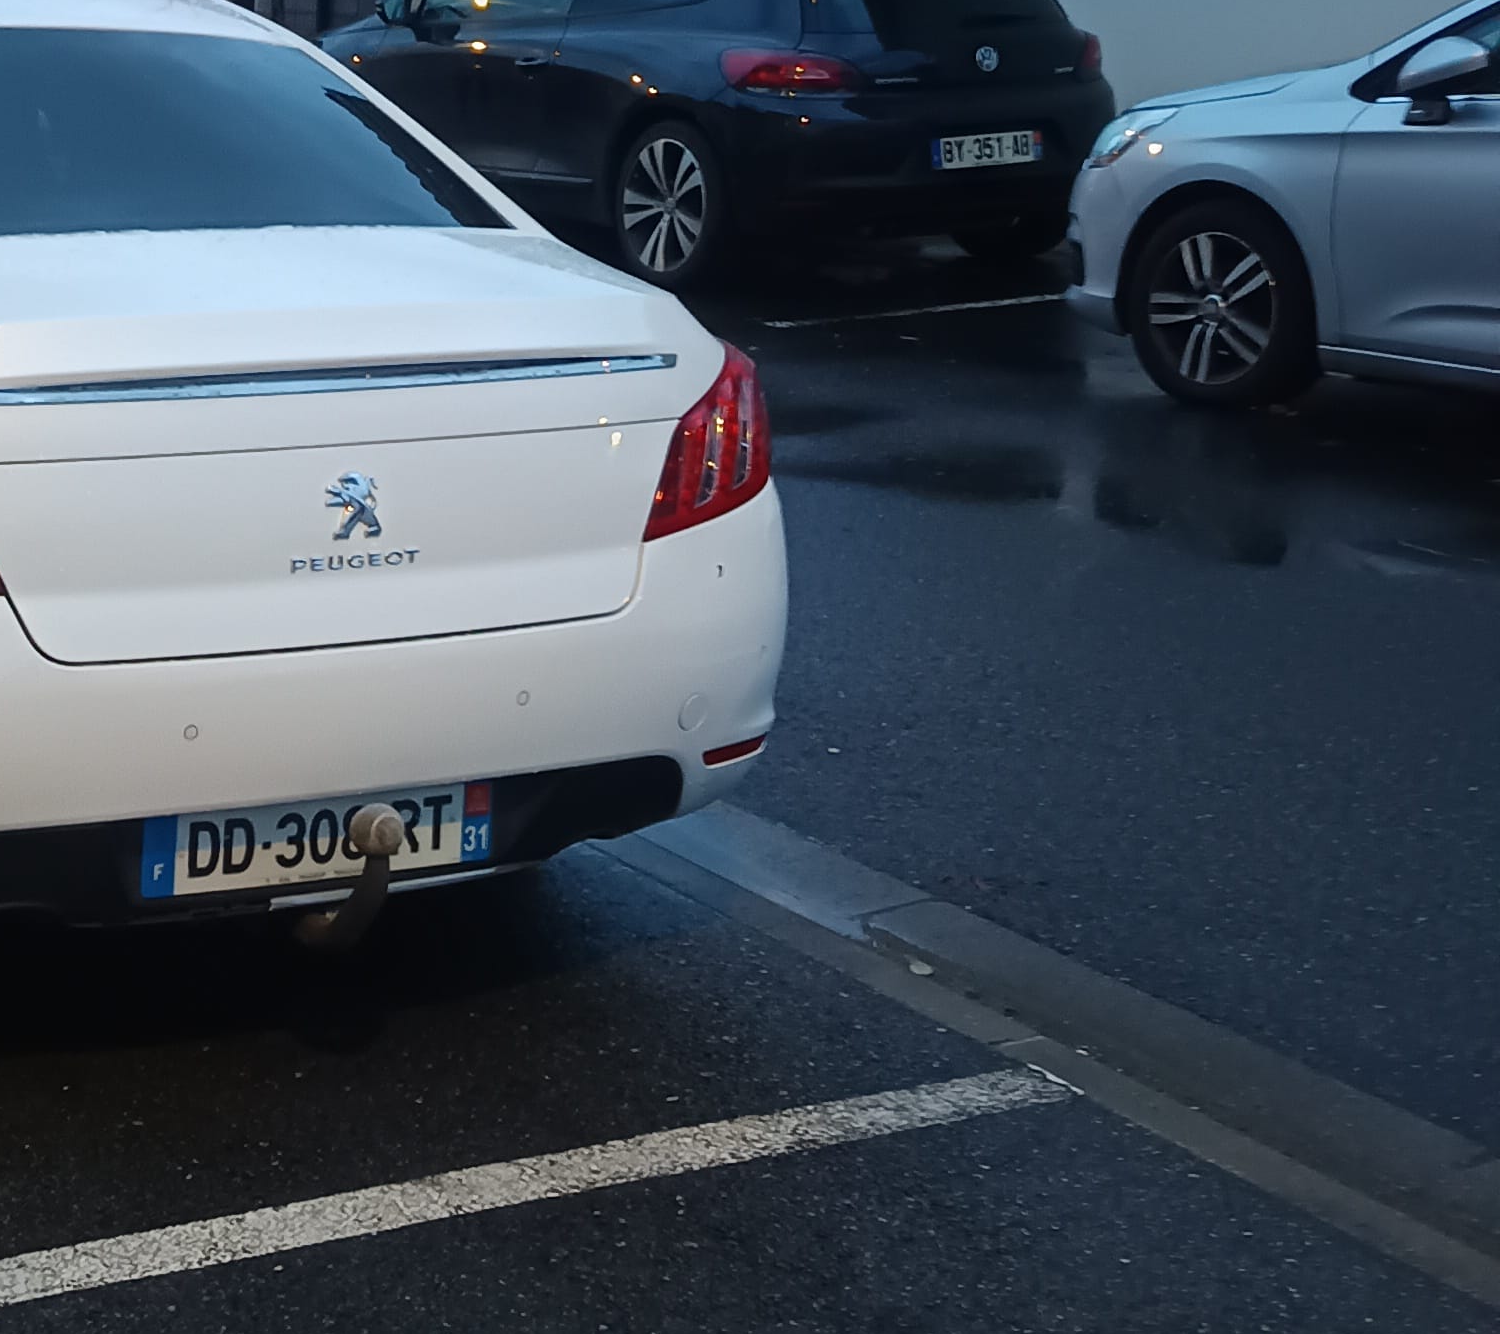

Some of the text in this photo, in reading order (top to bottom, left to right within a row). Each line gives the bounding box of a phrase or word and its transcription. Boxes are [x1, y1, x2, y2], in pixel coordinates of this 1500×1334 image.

[290, 549, 420, 574] PEUGEOT
[153, 863, 165, 881] F
[464, 823, 489, 852] 31
